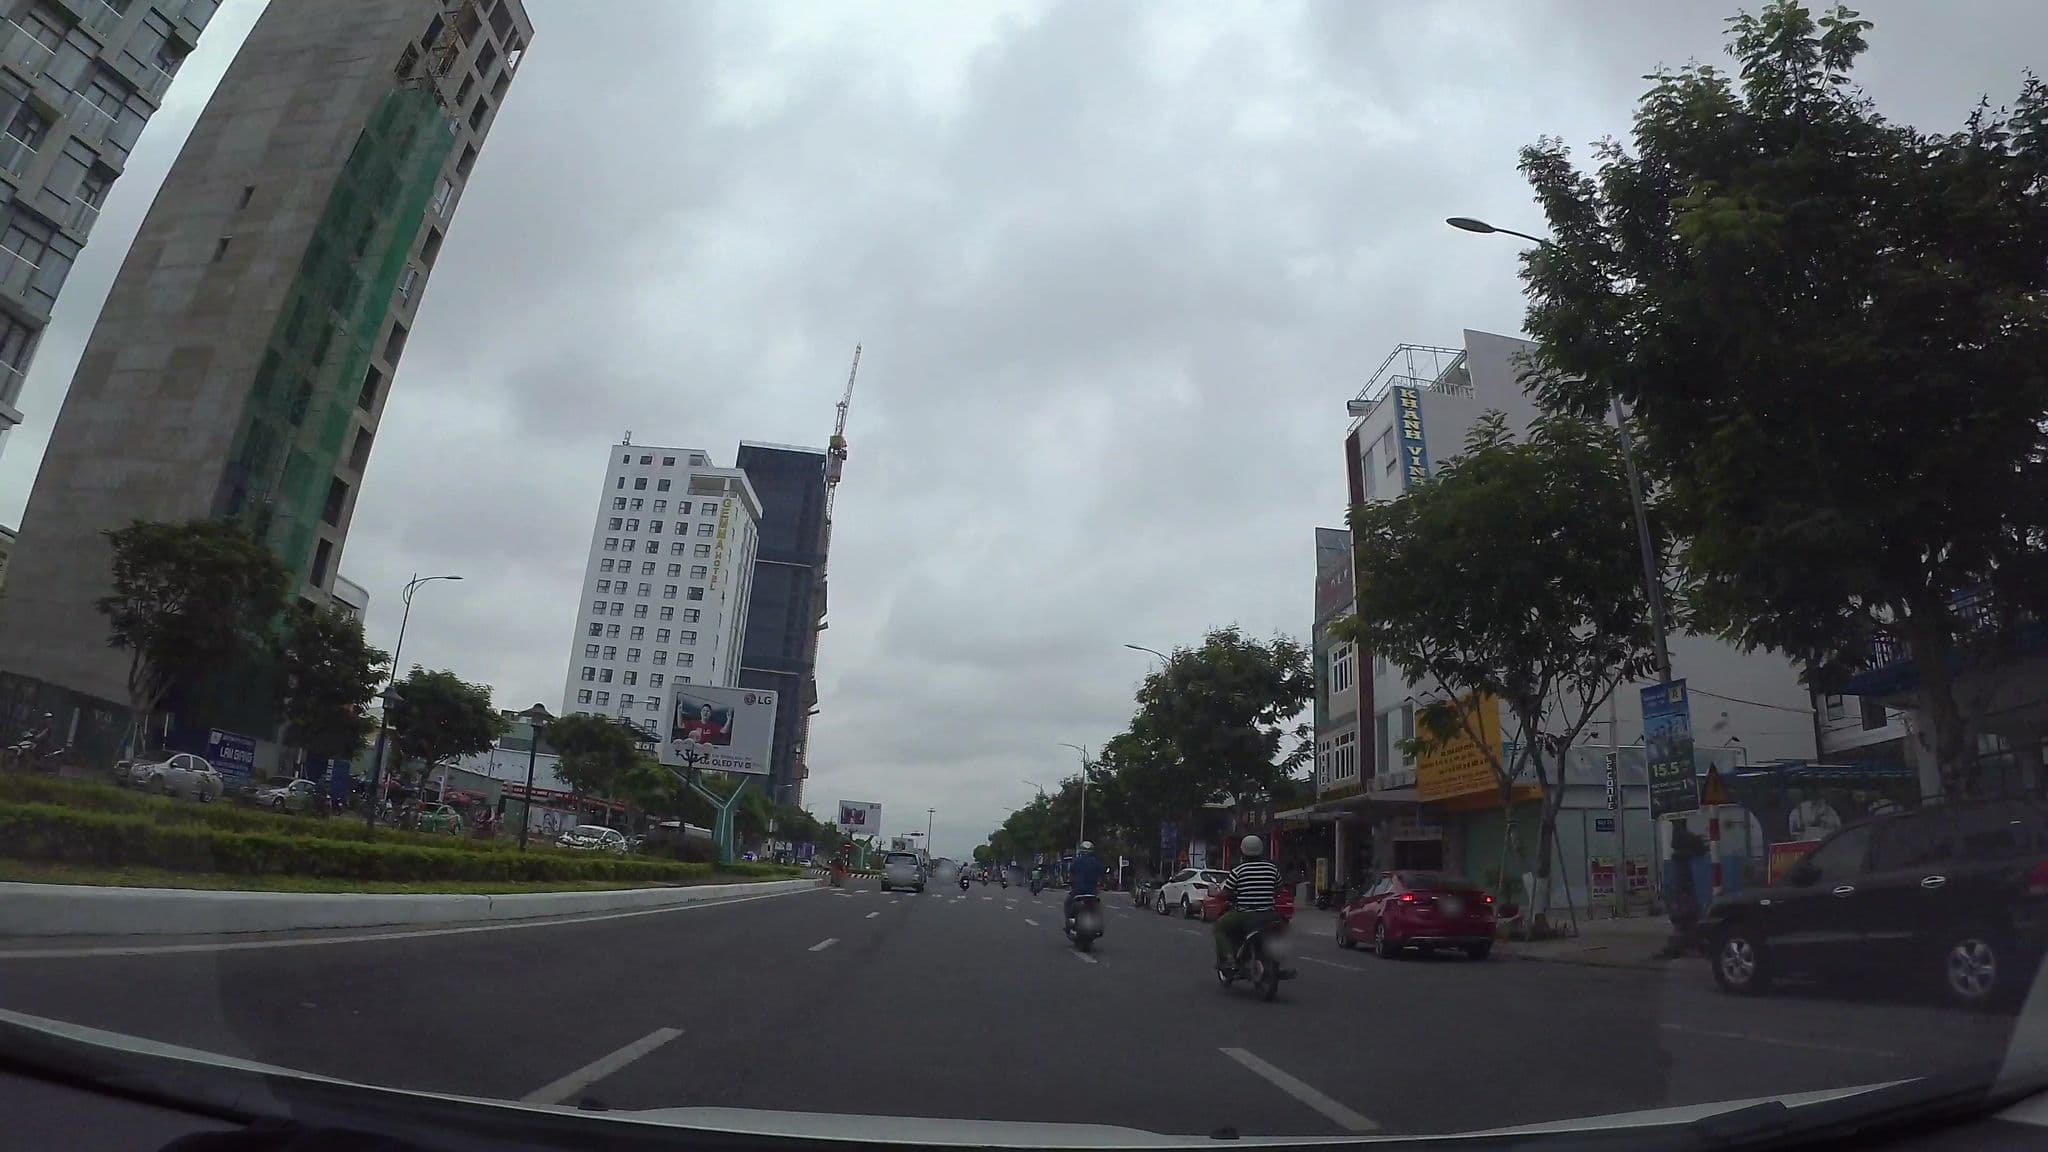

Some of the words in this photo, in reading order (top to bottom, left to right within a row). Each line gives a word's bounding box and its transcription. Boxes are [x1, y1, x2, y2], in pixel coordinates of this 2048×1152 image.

[709, 551, 722, 591] HOTEL
[758, 696, 772, 705] LG
[712, 758, 732, 768] OLED
[733, 760, 744, 769] TV
[1652, 761, 1680, 777] 15.5
